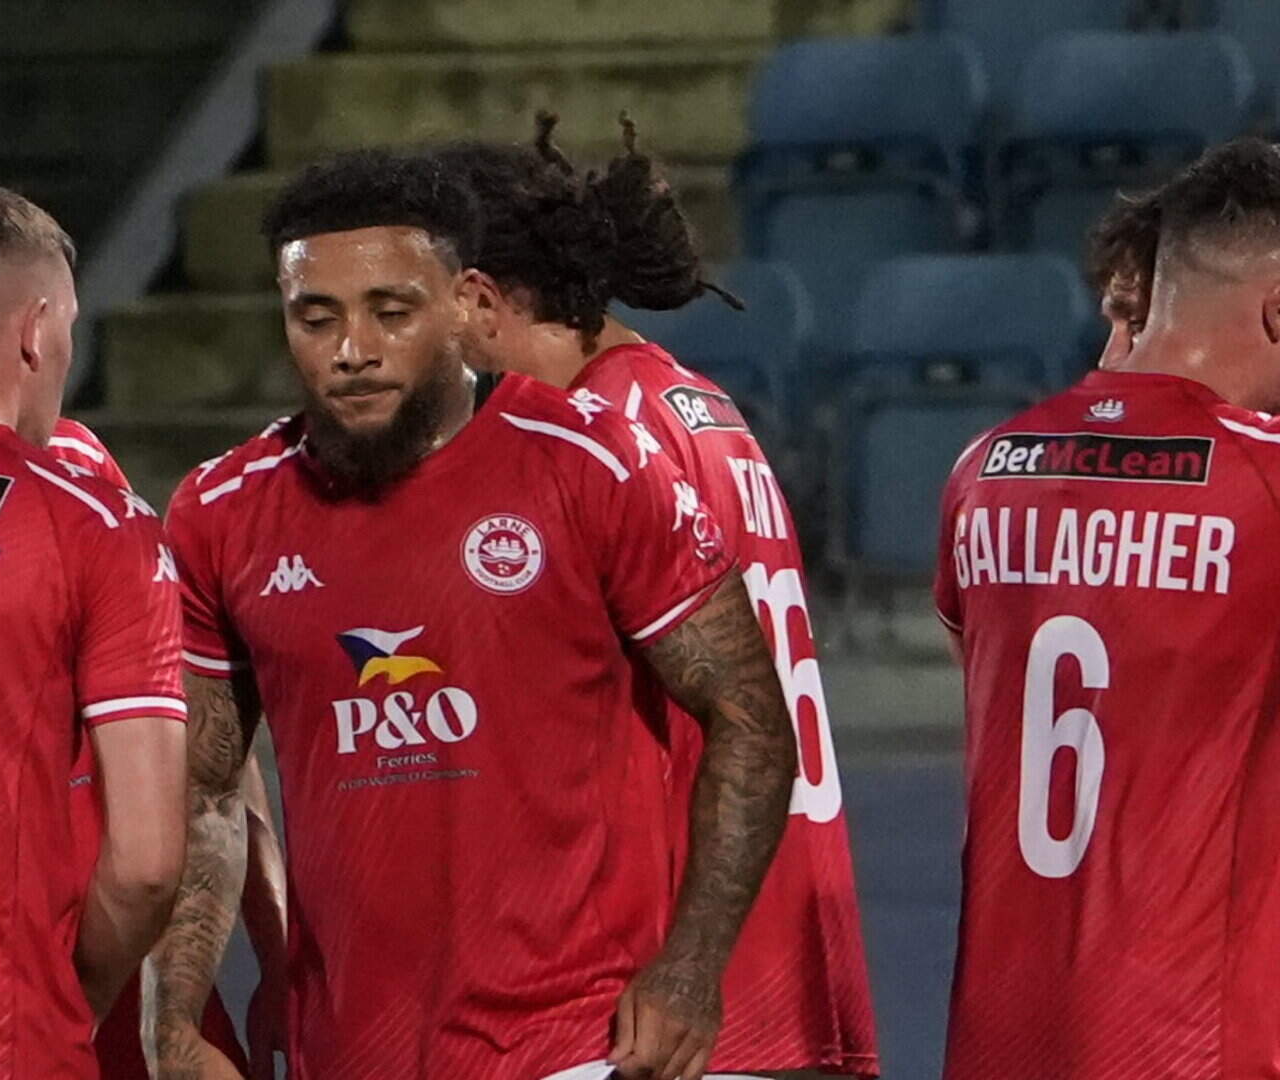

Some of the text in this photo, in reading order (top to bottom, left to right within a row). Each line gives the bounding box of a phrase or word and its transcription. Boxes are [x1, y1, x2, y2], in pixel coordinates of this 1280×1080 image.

[984, 439, 1202, 479] BetMcLean
[476, 518, 531, 537] LARNE
[953, 506, 1236, 595] GALLAGHER
[331, 686, 478, 754] P&O
[1018, 615, 1110, 878] 6
[376, 752, 438, 769] Ferries
